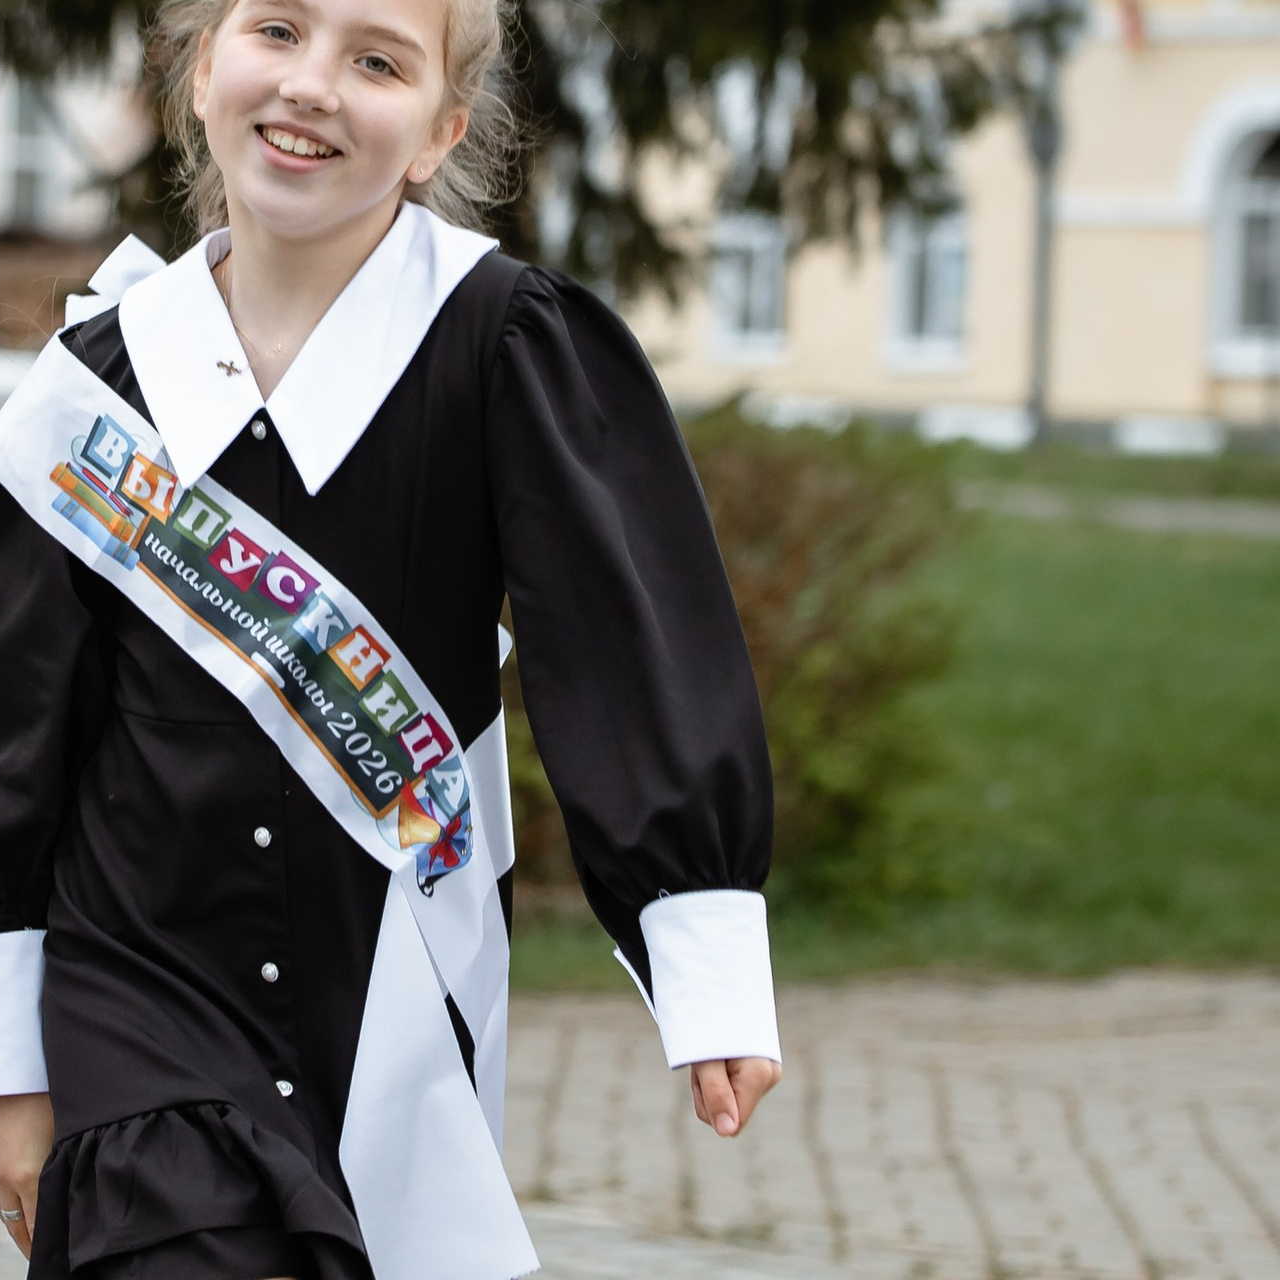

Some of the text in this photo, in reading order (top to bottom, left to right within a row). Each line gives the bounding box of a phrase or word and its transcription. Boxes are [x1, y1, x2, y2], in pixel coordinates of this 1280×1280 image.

[94, 423, 465, 810] ВЫПУСКНИЦА
[144, 531, 403, 794] начальной школы 2026
